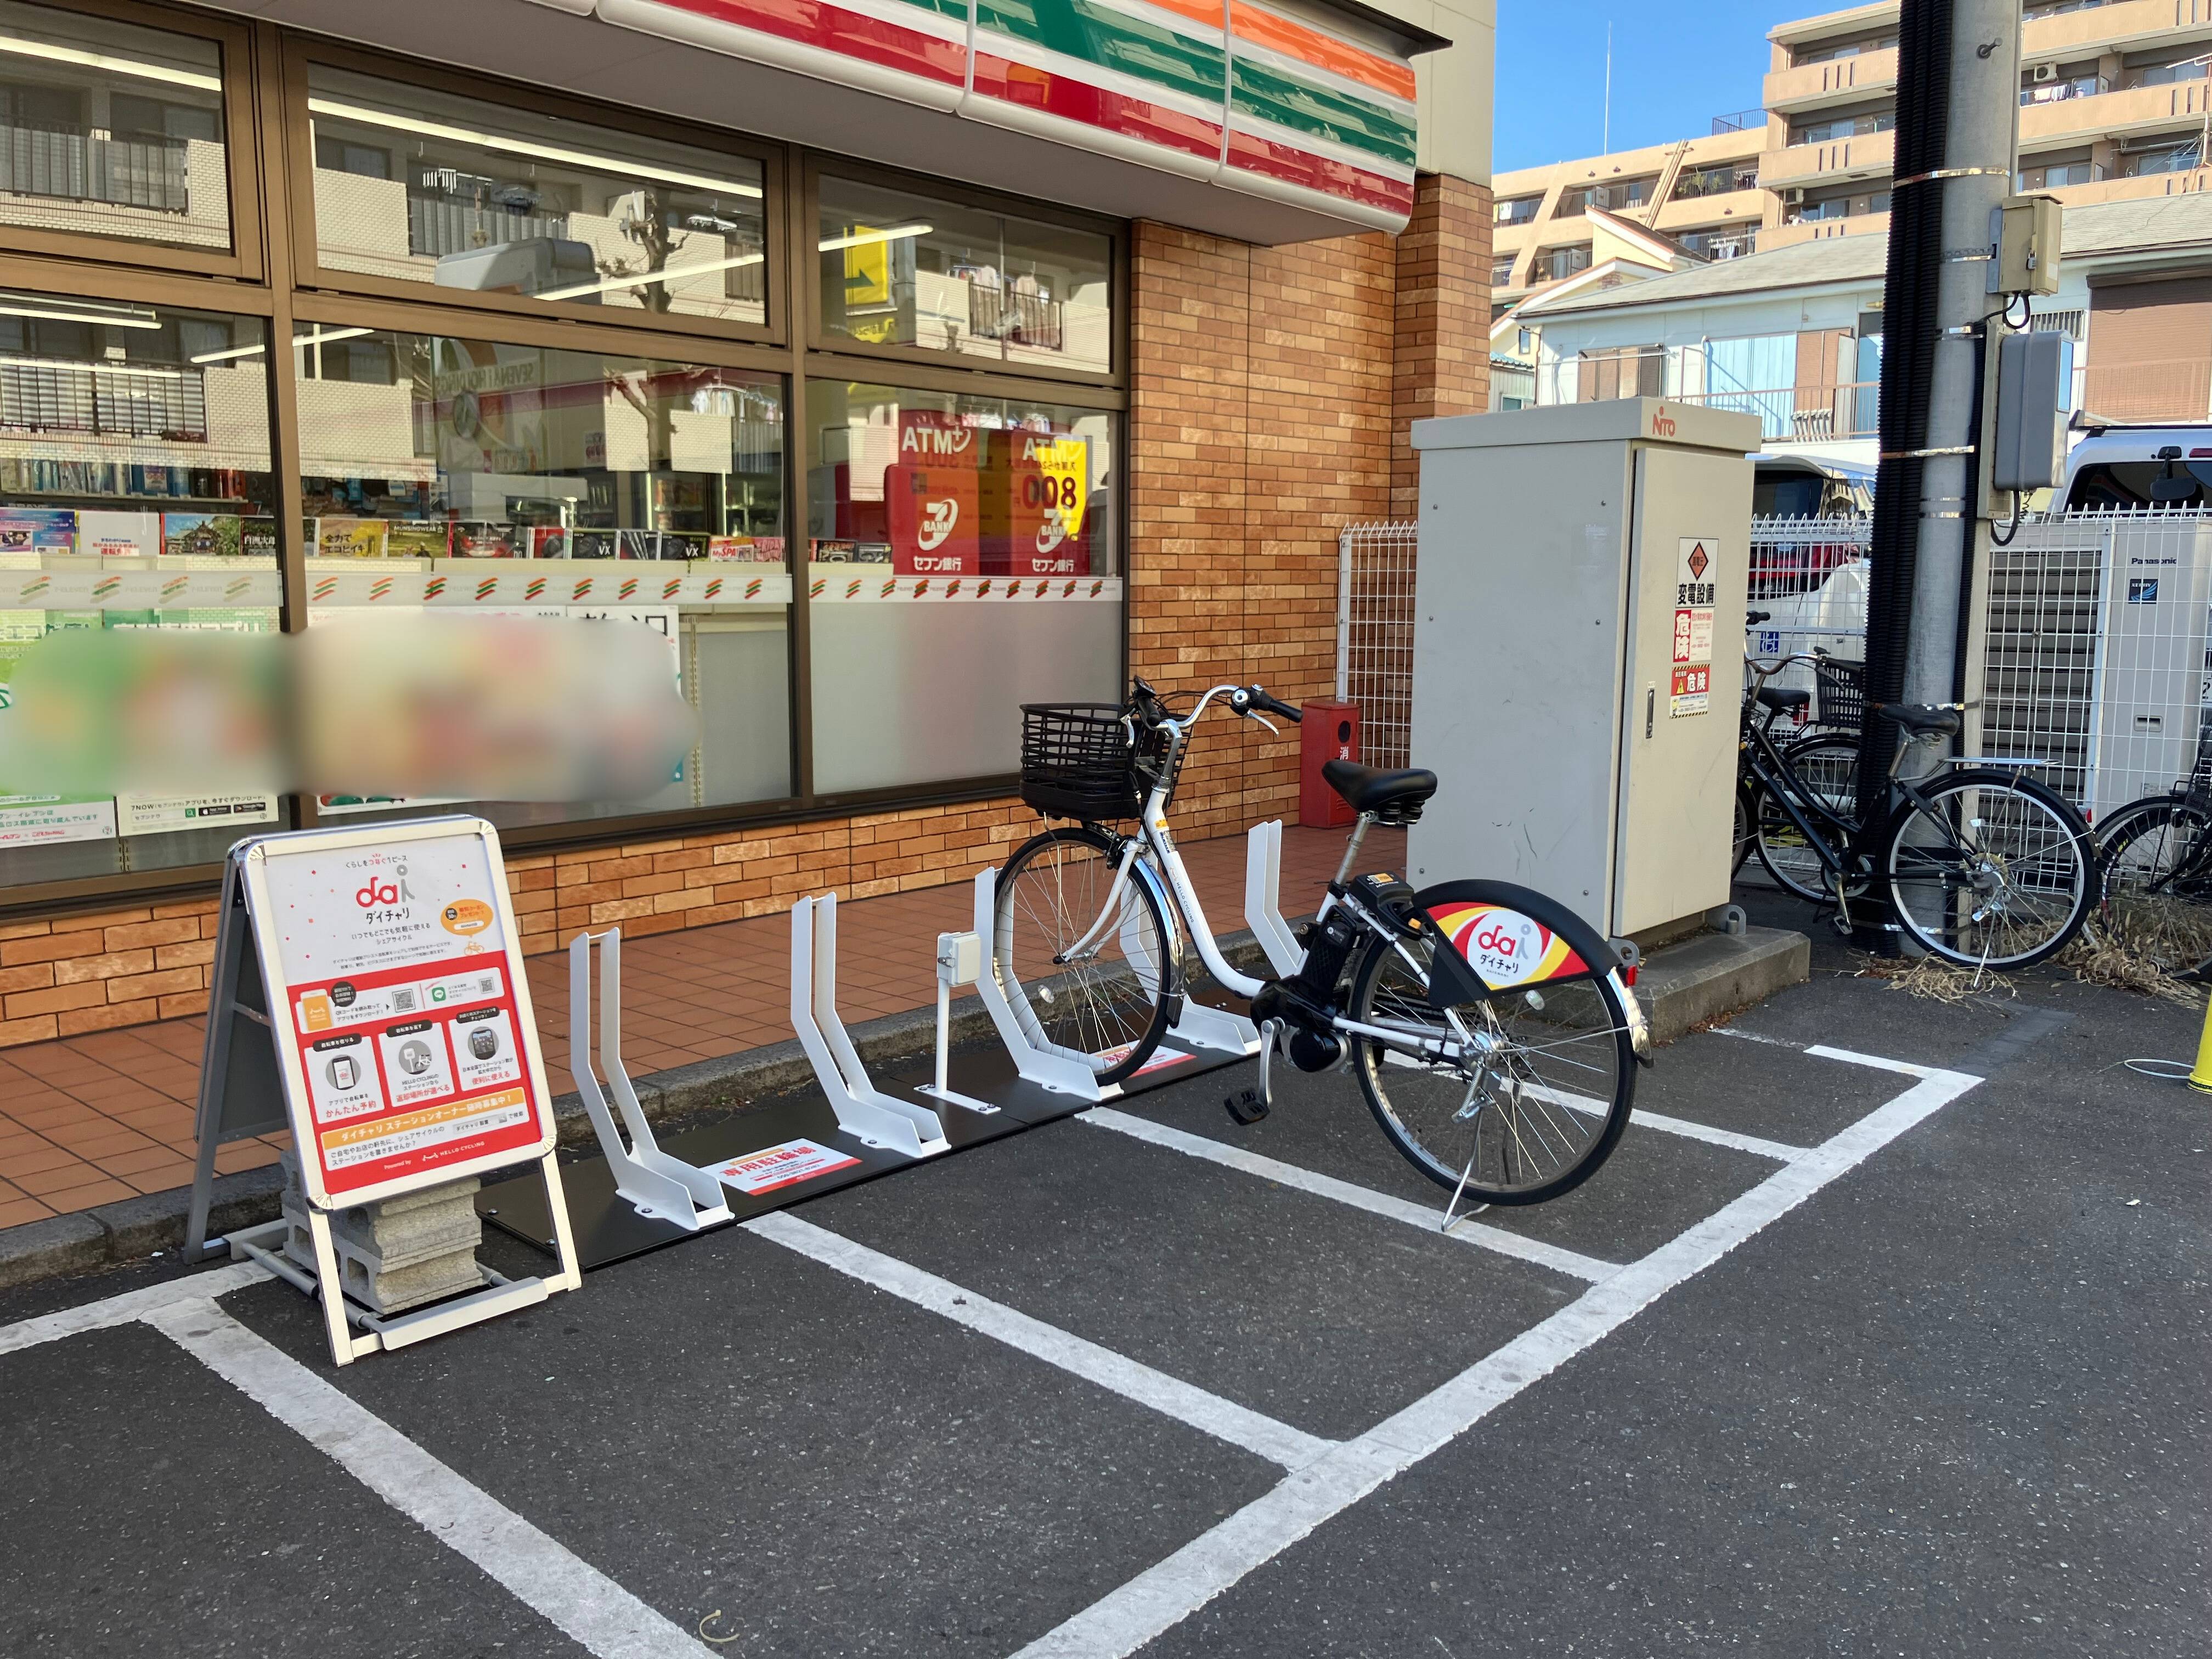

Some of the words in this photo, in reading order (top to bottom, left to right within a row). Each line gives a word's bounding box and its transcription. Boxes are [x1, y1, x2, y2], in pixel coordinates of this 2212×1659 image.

[913, 556, 962, 571] セブン銀行
[1031, 557, 1074, 573] セブン銀行
[1677, 583, 1715, 605] 変電設備
[1675, 613, 1690, 659] 危険
[1687, 671, 1707, 692] 危険
[1177, 882, 1186, 899] HELLO
[366, 907, 410, 924] ダイチャリ
[352, 922, 431, 940] いつでもどこでも気軽に使える
[1480, 954, 1519, 973] ダイチャリ
[326, 1101, 377, 1118] かんたん予約
[342, 1125, 383, 1142] ダイチャリ
[439, 1147, 459, 1156] HELLO
